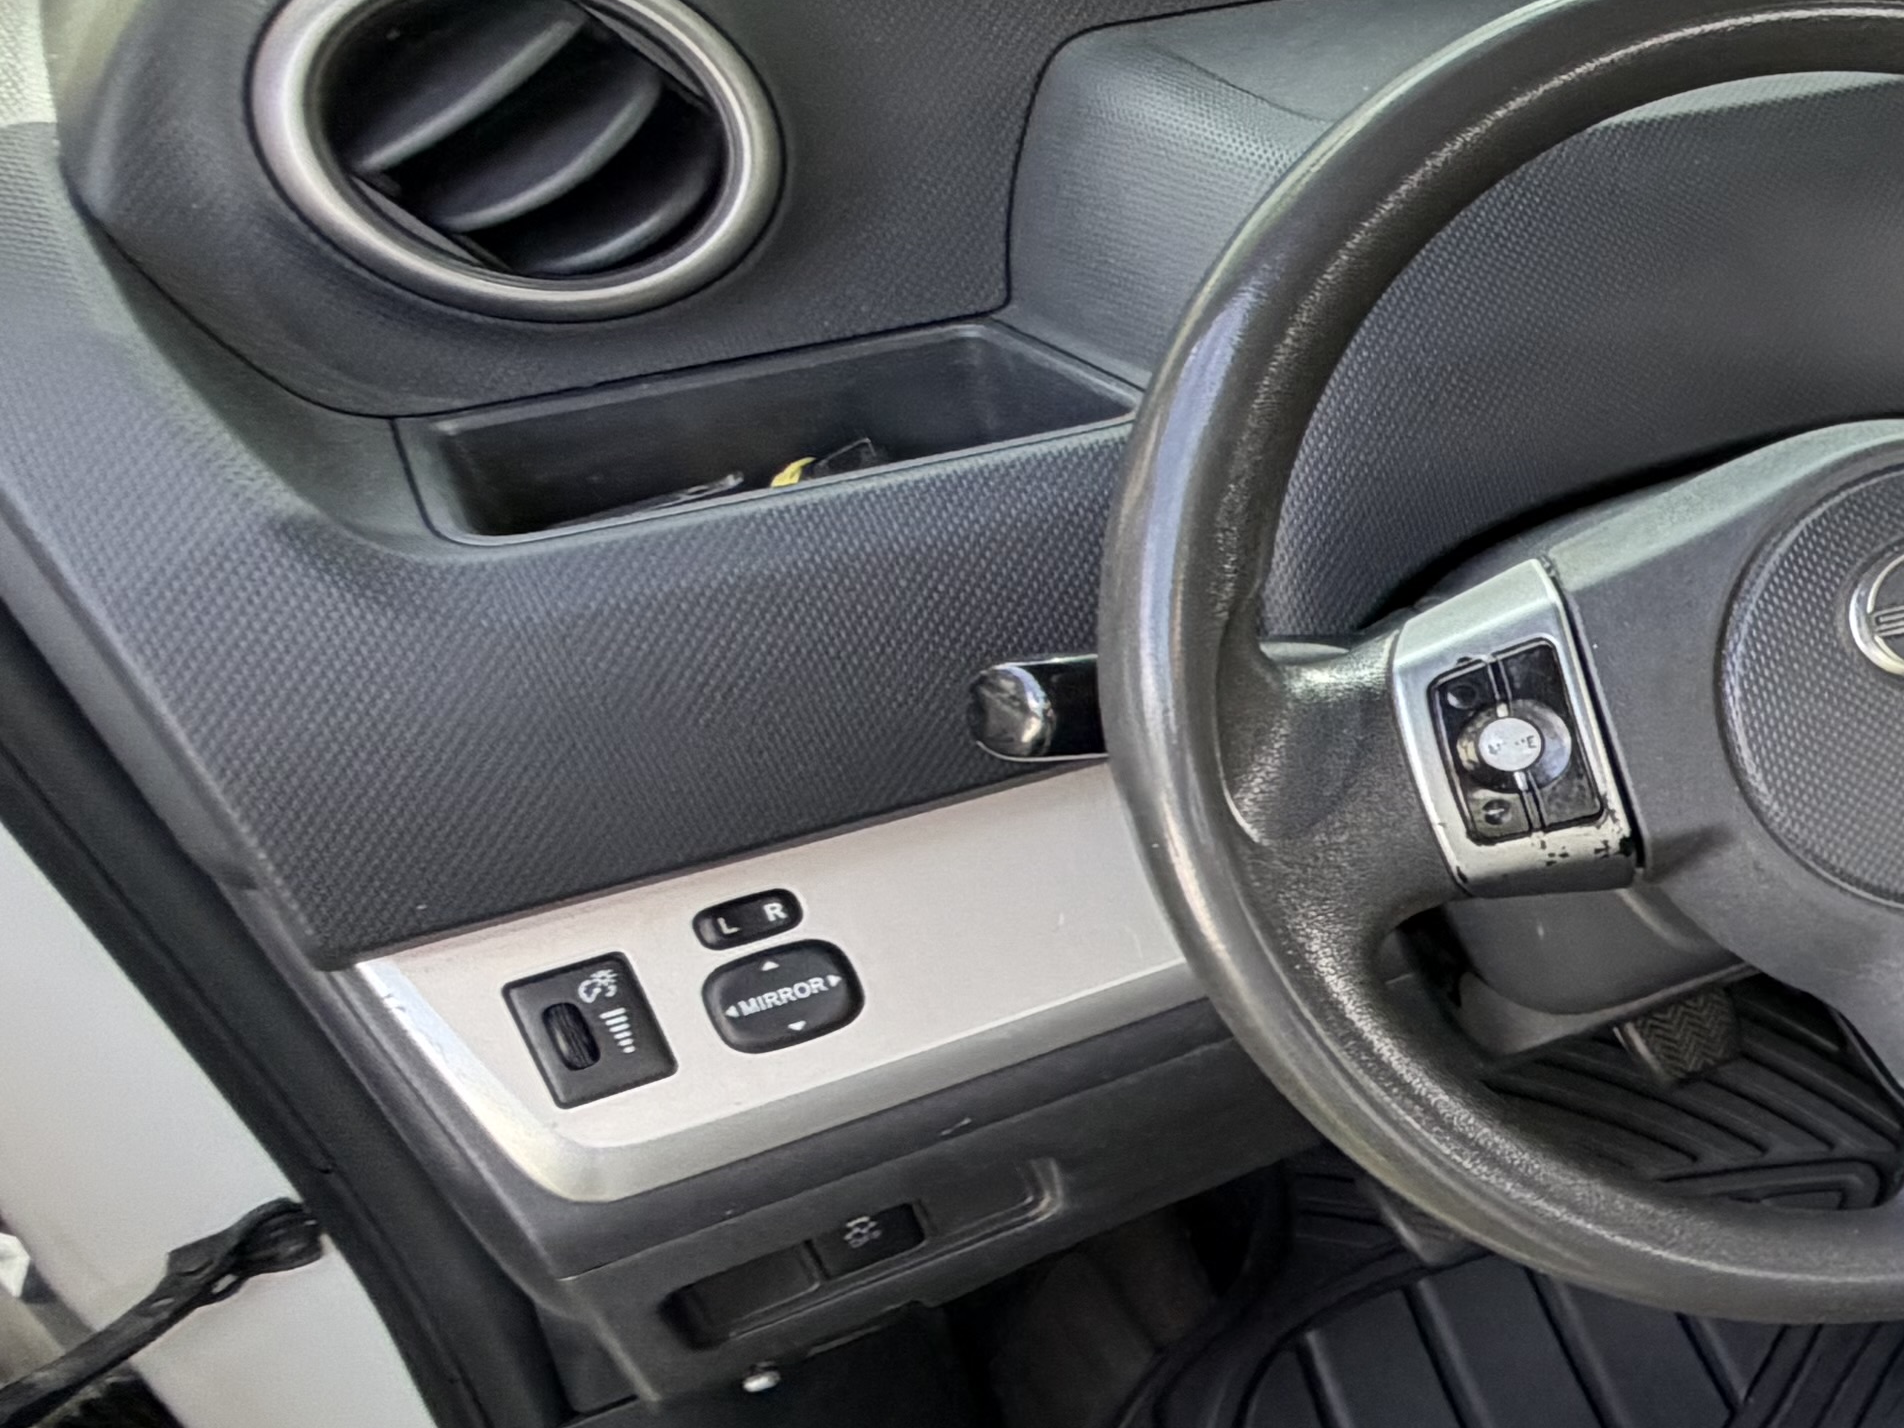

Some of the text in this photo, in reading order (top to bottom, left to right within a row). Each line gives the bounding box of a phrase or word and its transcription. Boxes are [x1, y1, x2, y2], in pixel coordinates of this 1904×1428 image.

[716, 902, 788, 935] L R
[738, 976, 828, 1017] MIRROR
